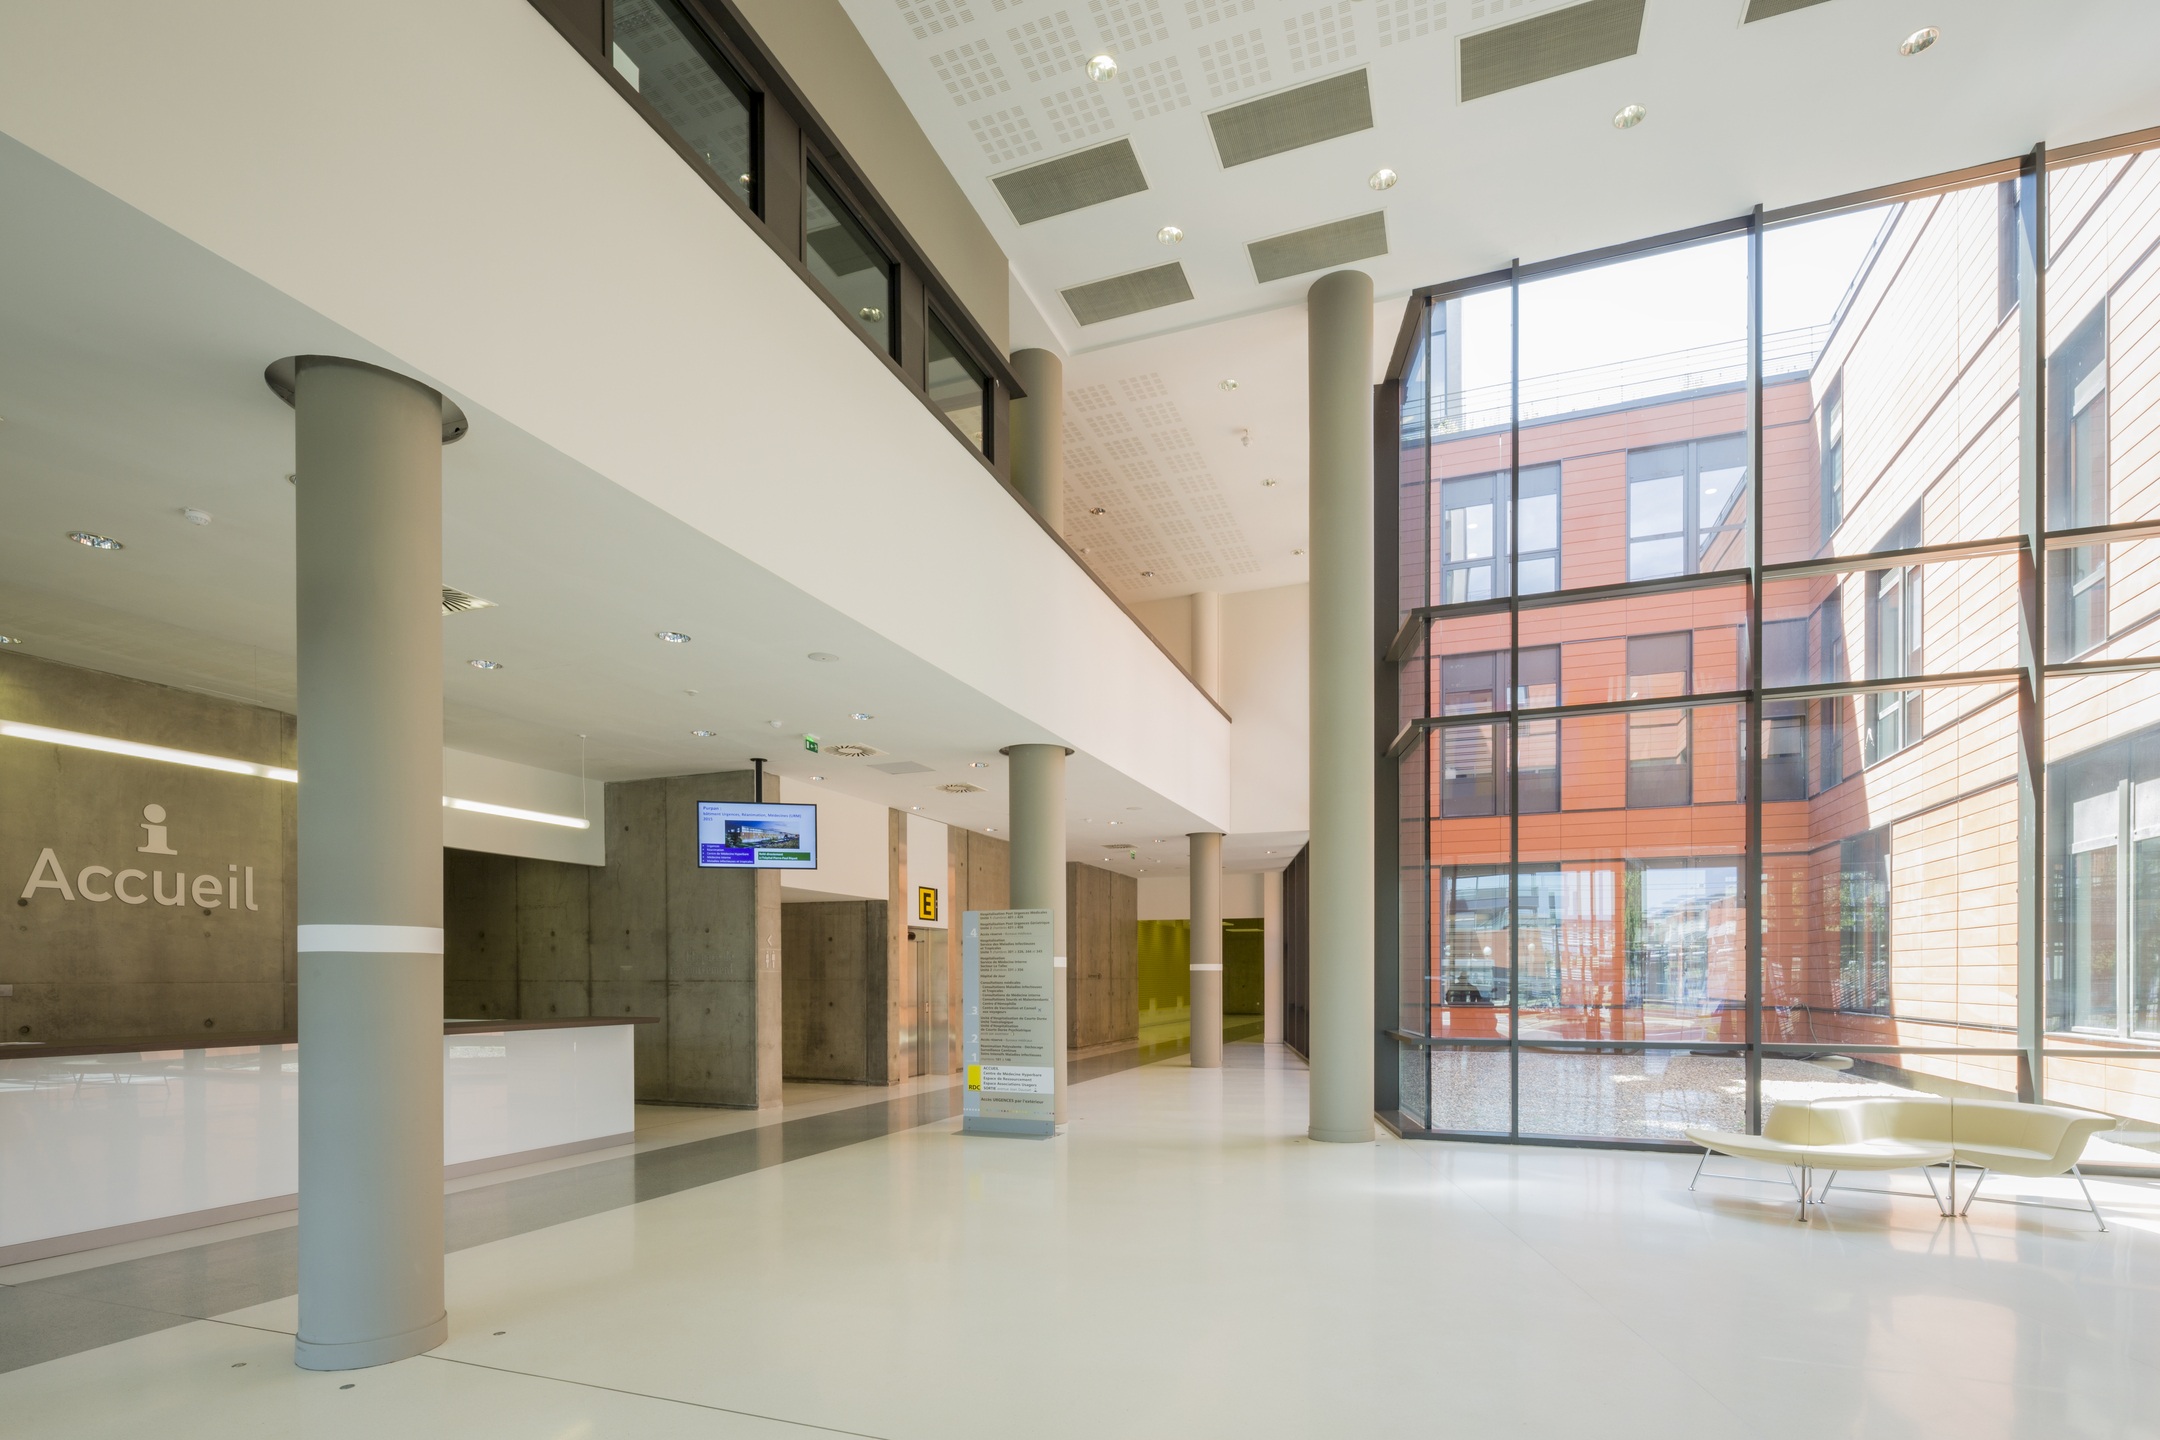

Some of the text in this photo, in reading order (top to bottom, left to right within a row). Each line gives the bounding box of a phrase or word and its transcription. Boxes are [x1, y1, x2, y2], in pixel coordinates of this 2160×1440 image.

[20, 847, 258, 911] Accueil
[924, 892, 931, 915] E
[970, 928, 977, 937] 4
[971, 1006, 978, 1014] 3
[971, 1033, 978, 1043] 2
[972, 1053, 977, 1062] 1
